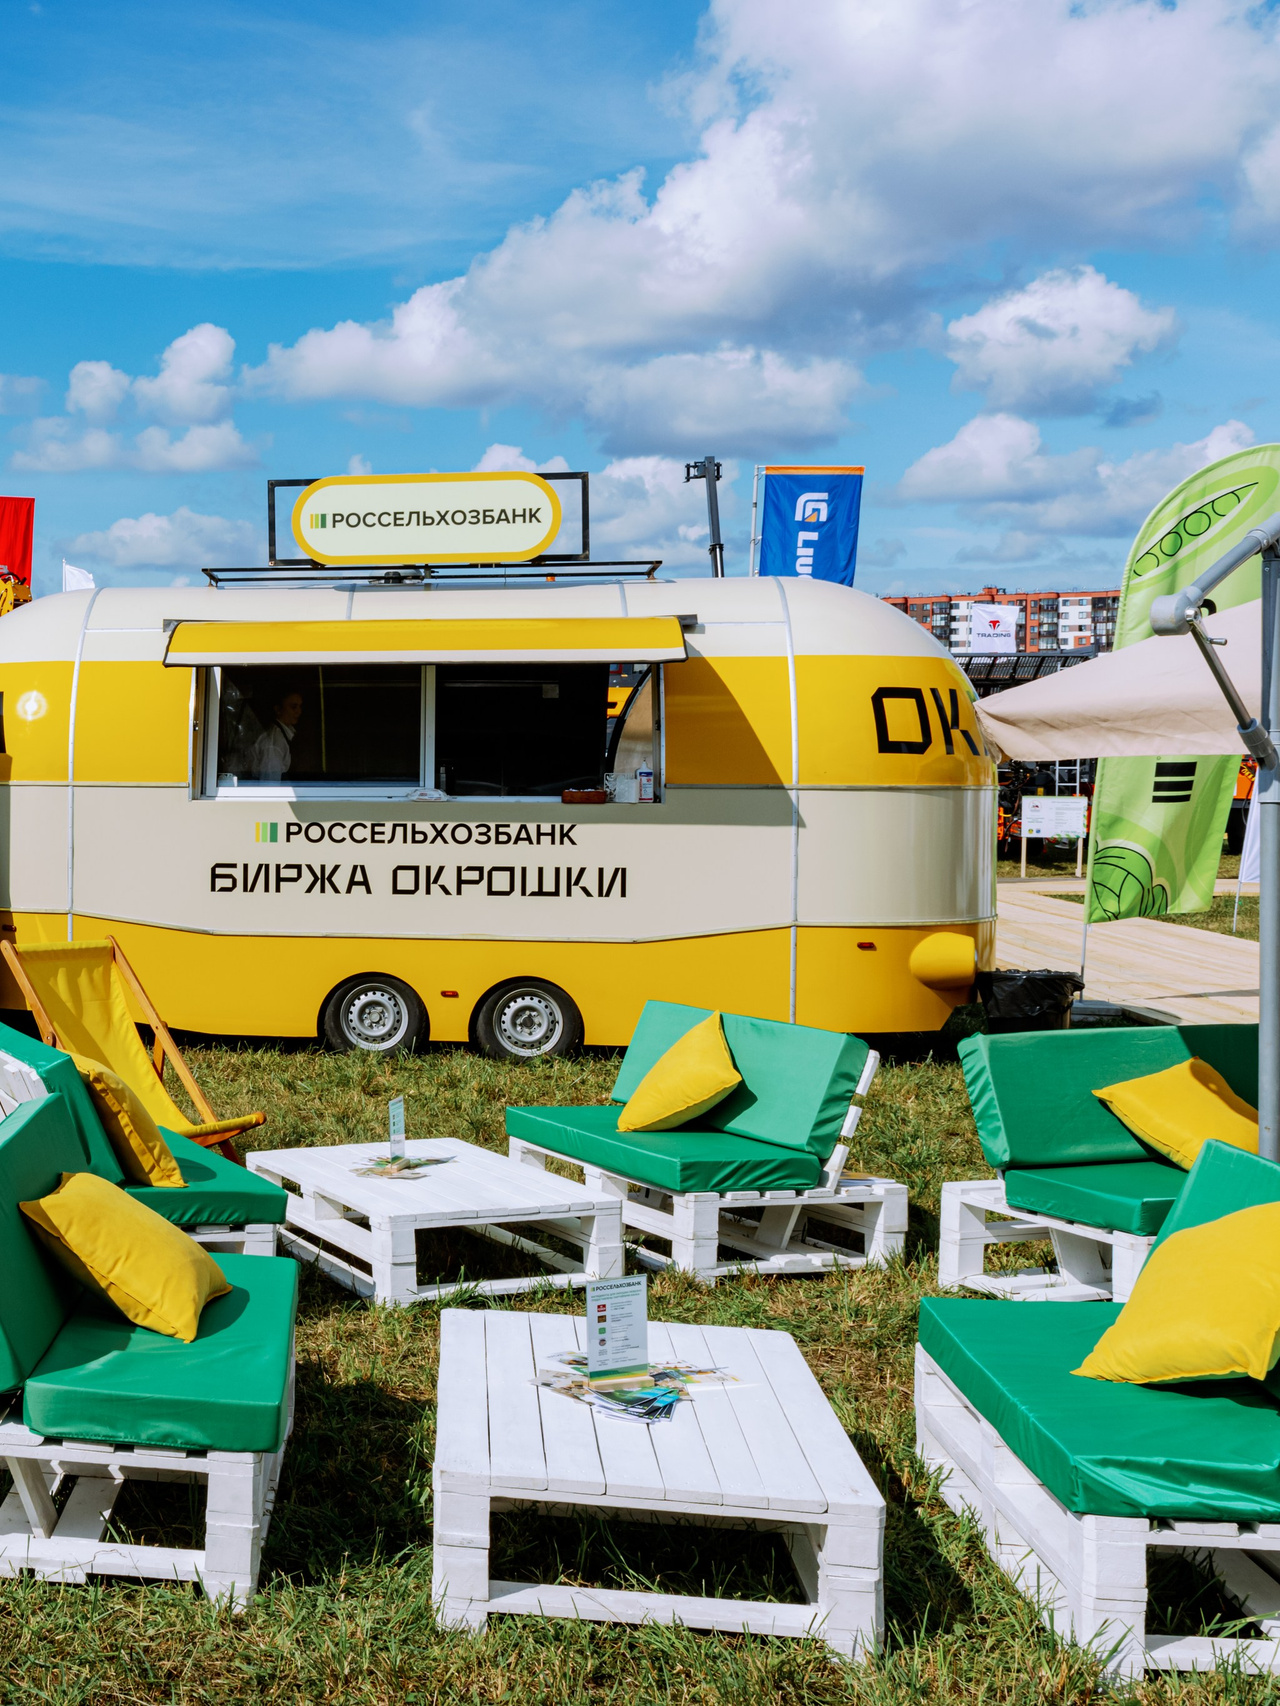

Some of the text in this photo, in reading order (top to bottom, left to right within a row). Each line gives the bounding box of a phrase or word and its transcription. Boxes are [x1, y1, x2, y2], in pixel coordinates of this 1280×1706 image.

[331, 507, 542, 529] РОССЕЛЬХОЗБАНК
[795, 531, 819, 580] LIU
[871, 686, 989, 756] ОК
[285, 821, 578, 846] РОССЕЛЬХОЗБАНК
[209, 862, 628, 898] БИРЖА ОКРОШКИ
[595, 1281, 642, 1291] РОССЕЛЬХОЗБАНК
